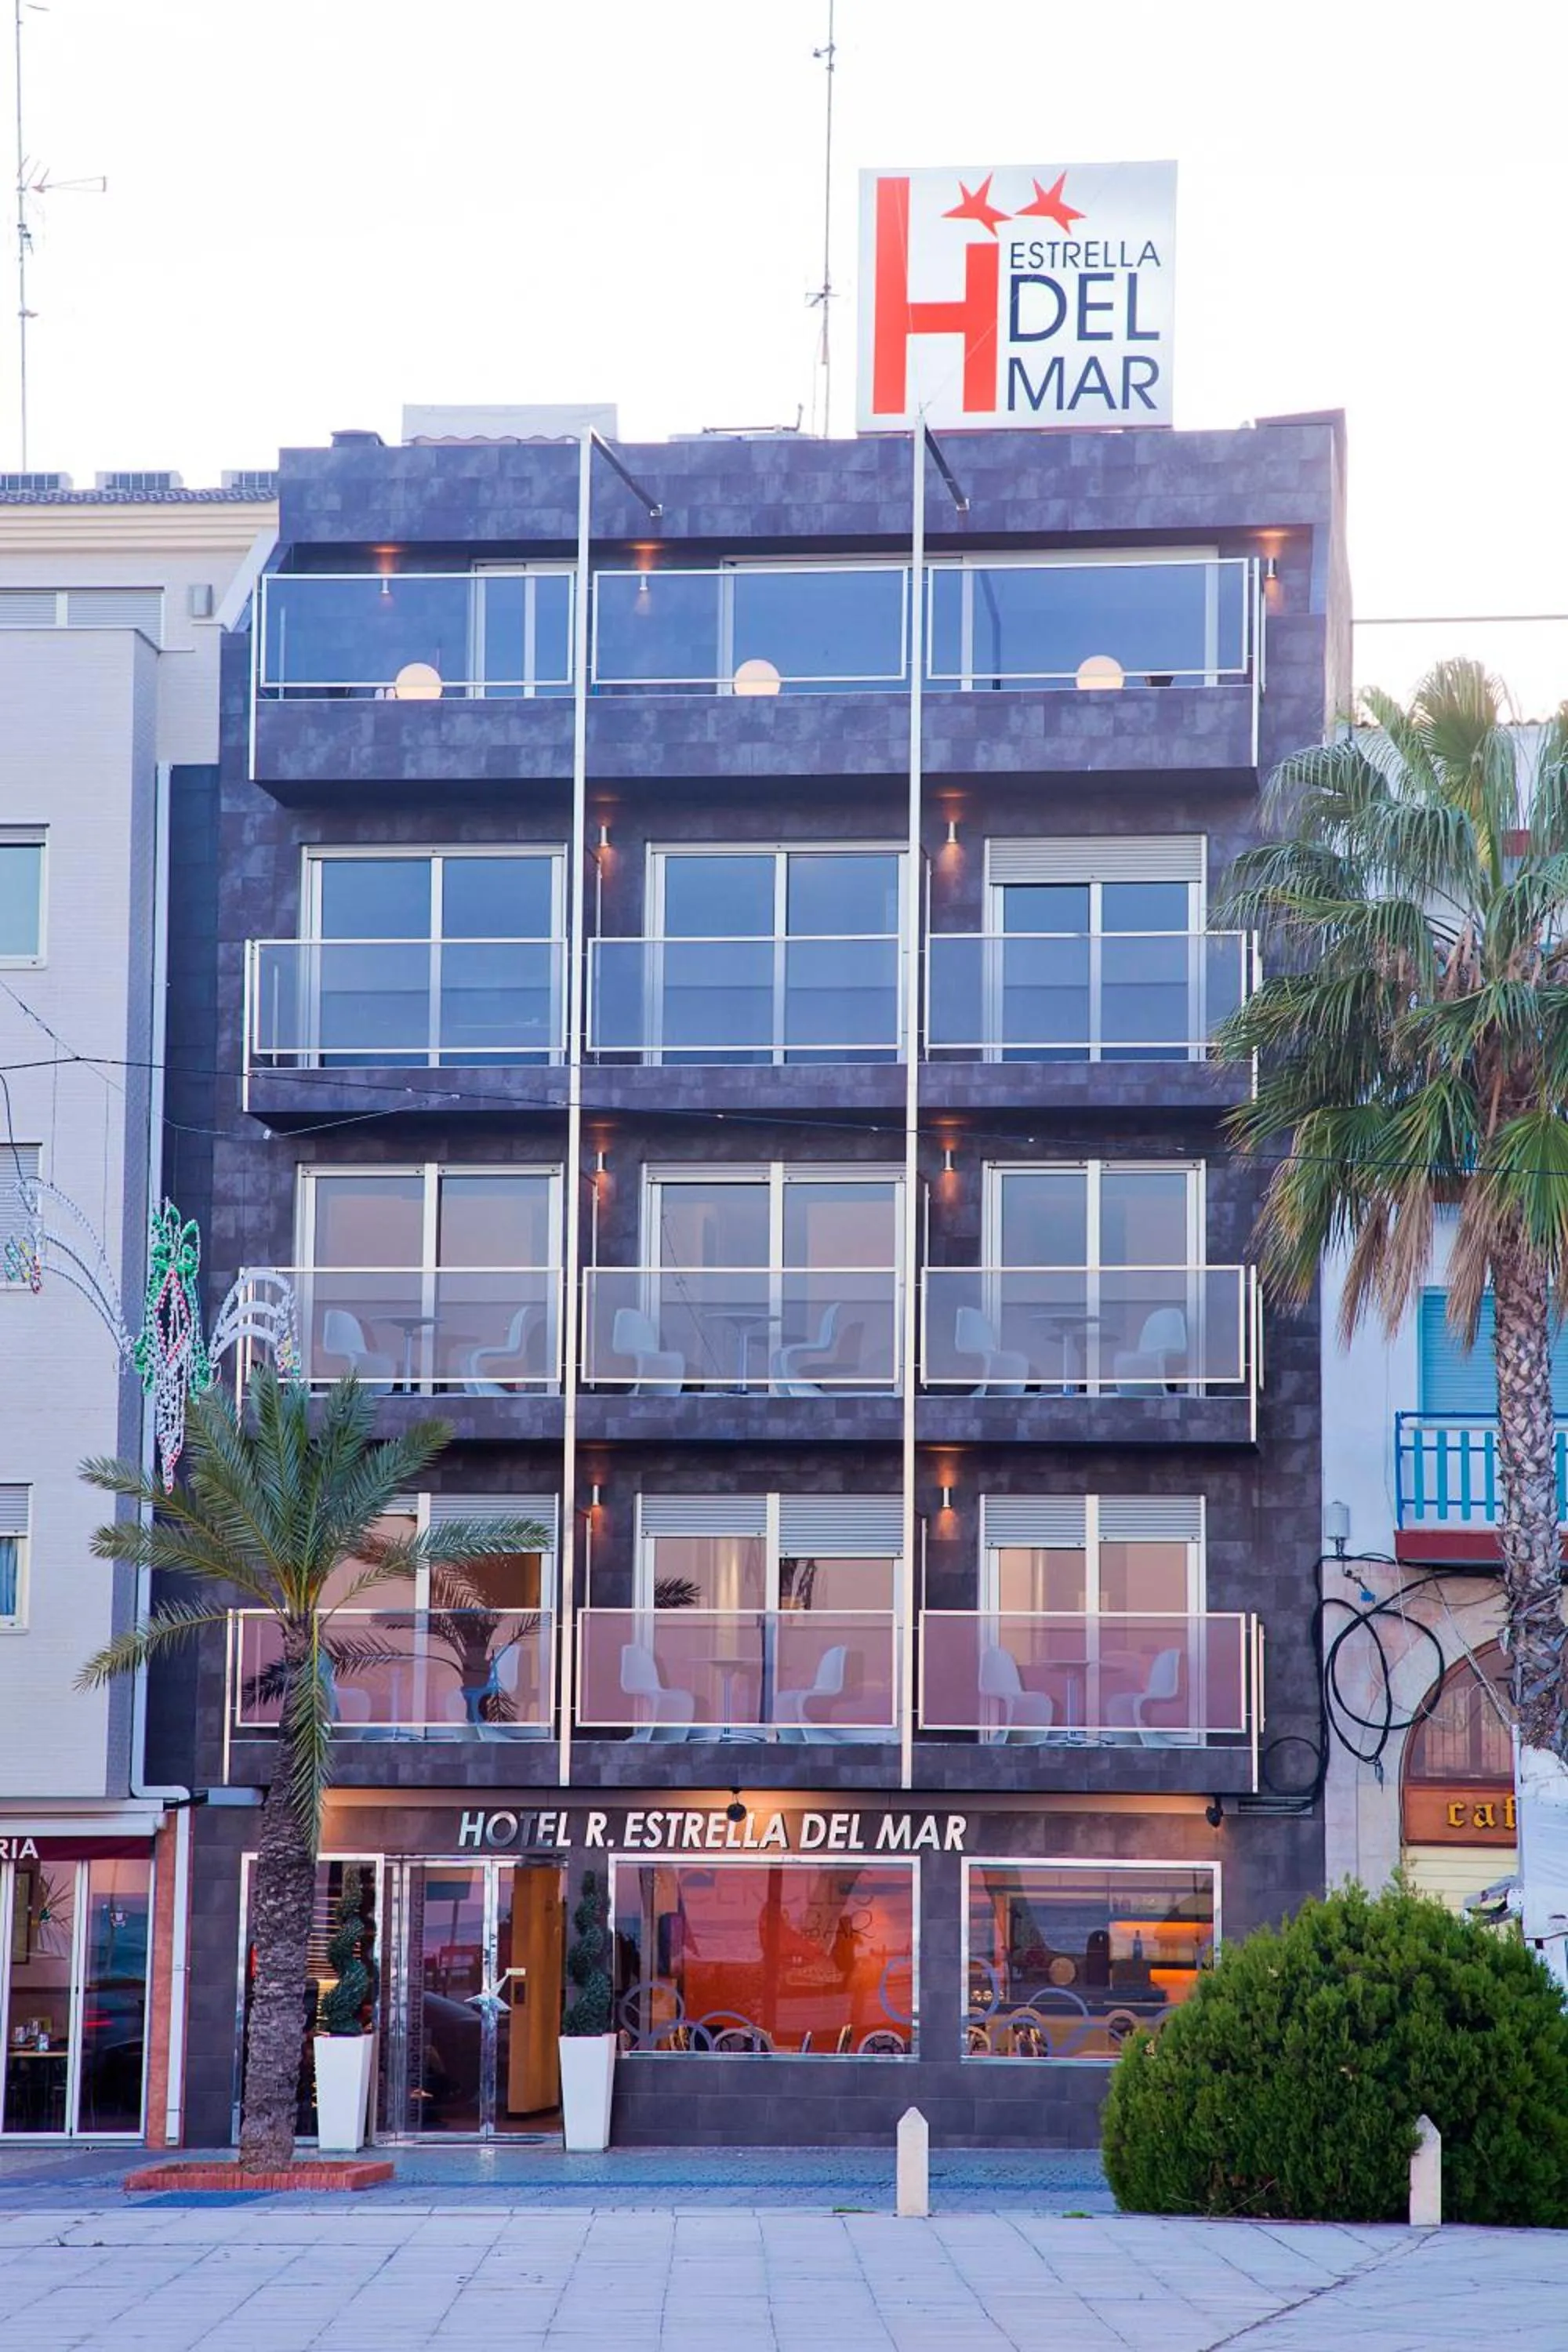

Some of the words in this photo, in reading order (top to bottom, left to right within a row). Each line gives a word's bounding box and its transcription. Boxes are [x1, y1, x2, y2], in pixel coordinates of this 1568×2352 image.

[1010, 241, 1161, 269] ESTRELLA
[1009, 272, 1160, 343] DEL
[1007, 355, 1160, 412] MAR
[458, 1810, 572, 1847] HOTEL
[585, 1811, 614, 1848] R.
[623, 1811, 787, 1849] ESTRELLA
[799, 1813, 865, 1850] DEL
[874, 1813, 967, 1851] MAR
